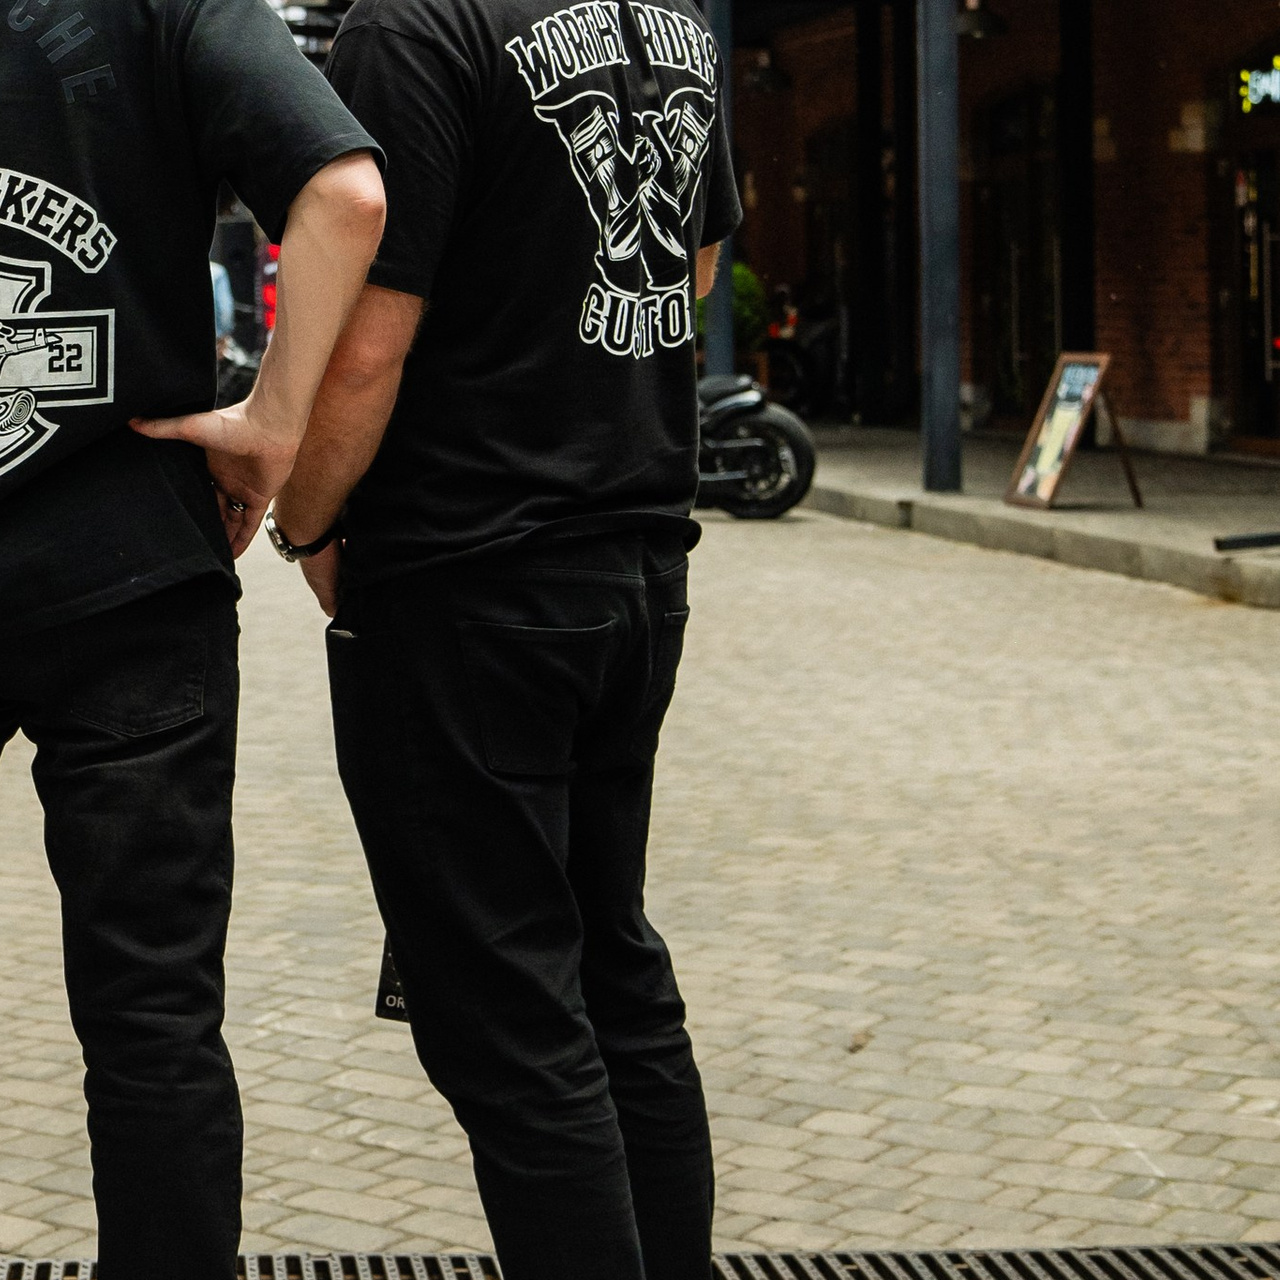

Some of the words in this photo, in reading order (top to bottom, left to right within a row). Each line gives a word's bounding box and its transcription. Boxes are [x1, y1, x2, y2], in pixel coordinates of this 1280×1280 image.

[505, 0, 630, 101] WORTHY
[47, 342, 84, 373] 22
[579, 282, 694, 360] CUSTO
